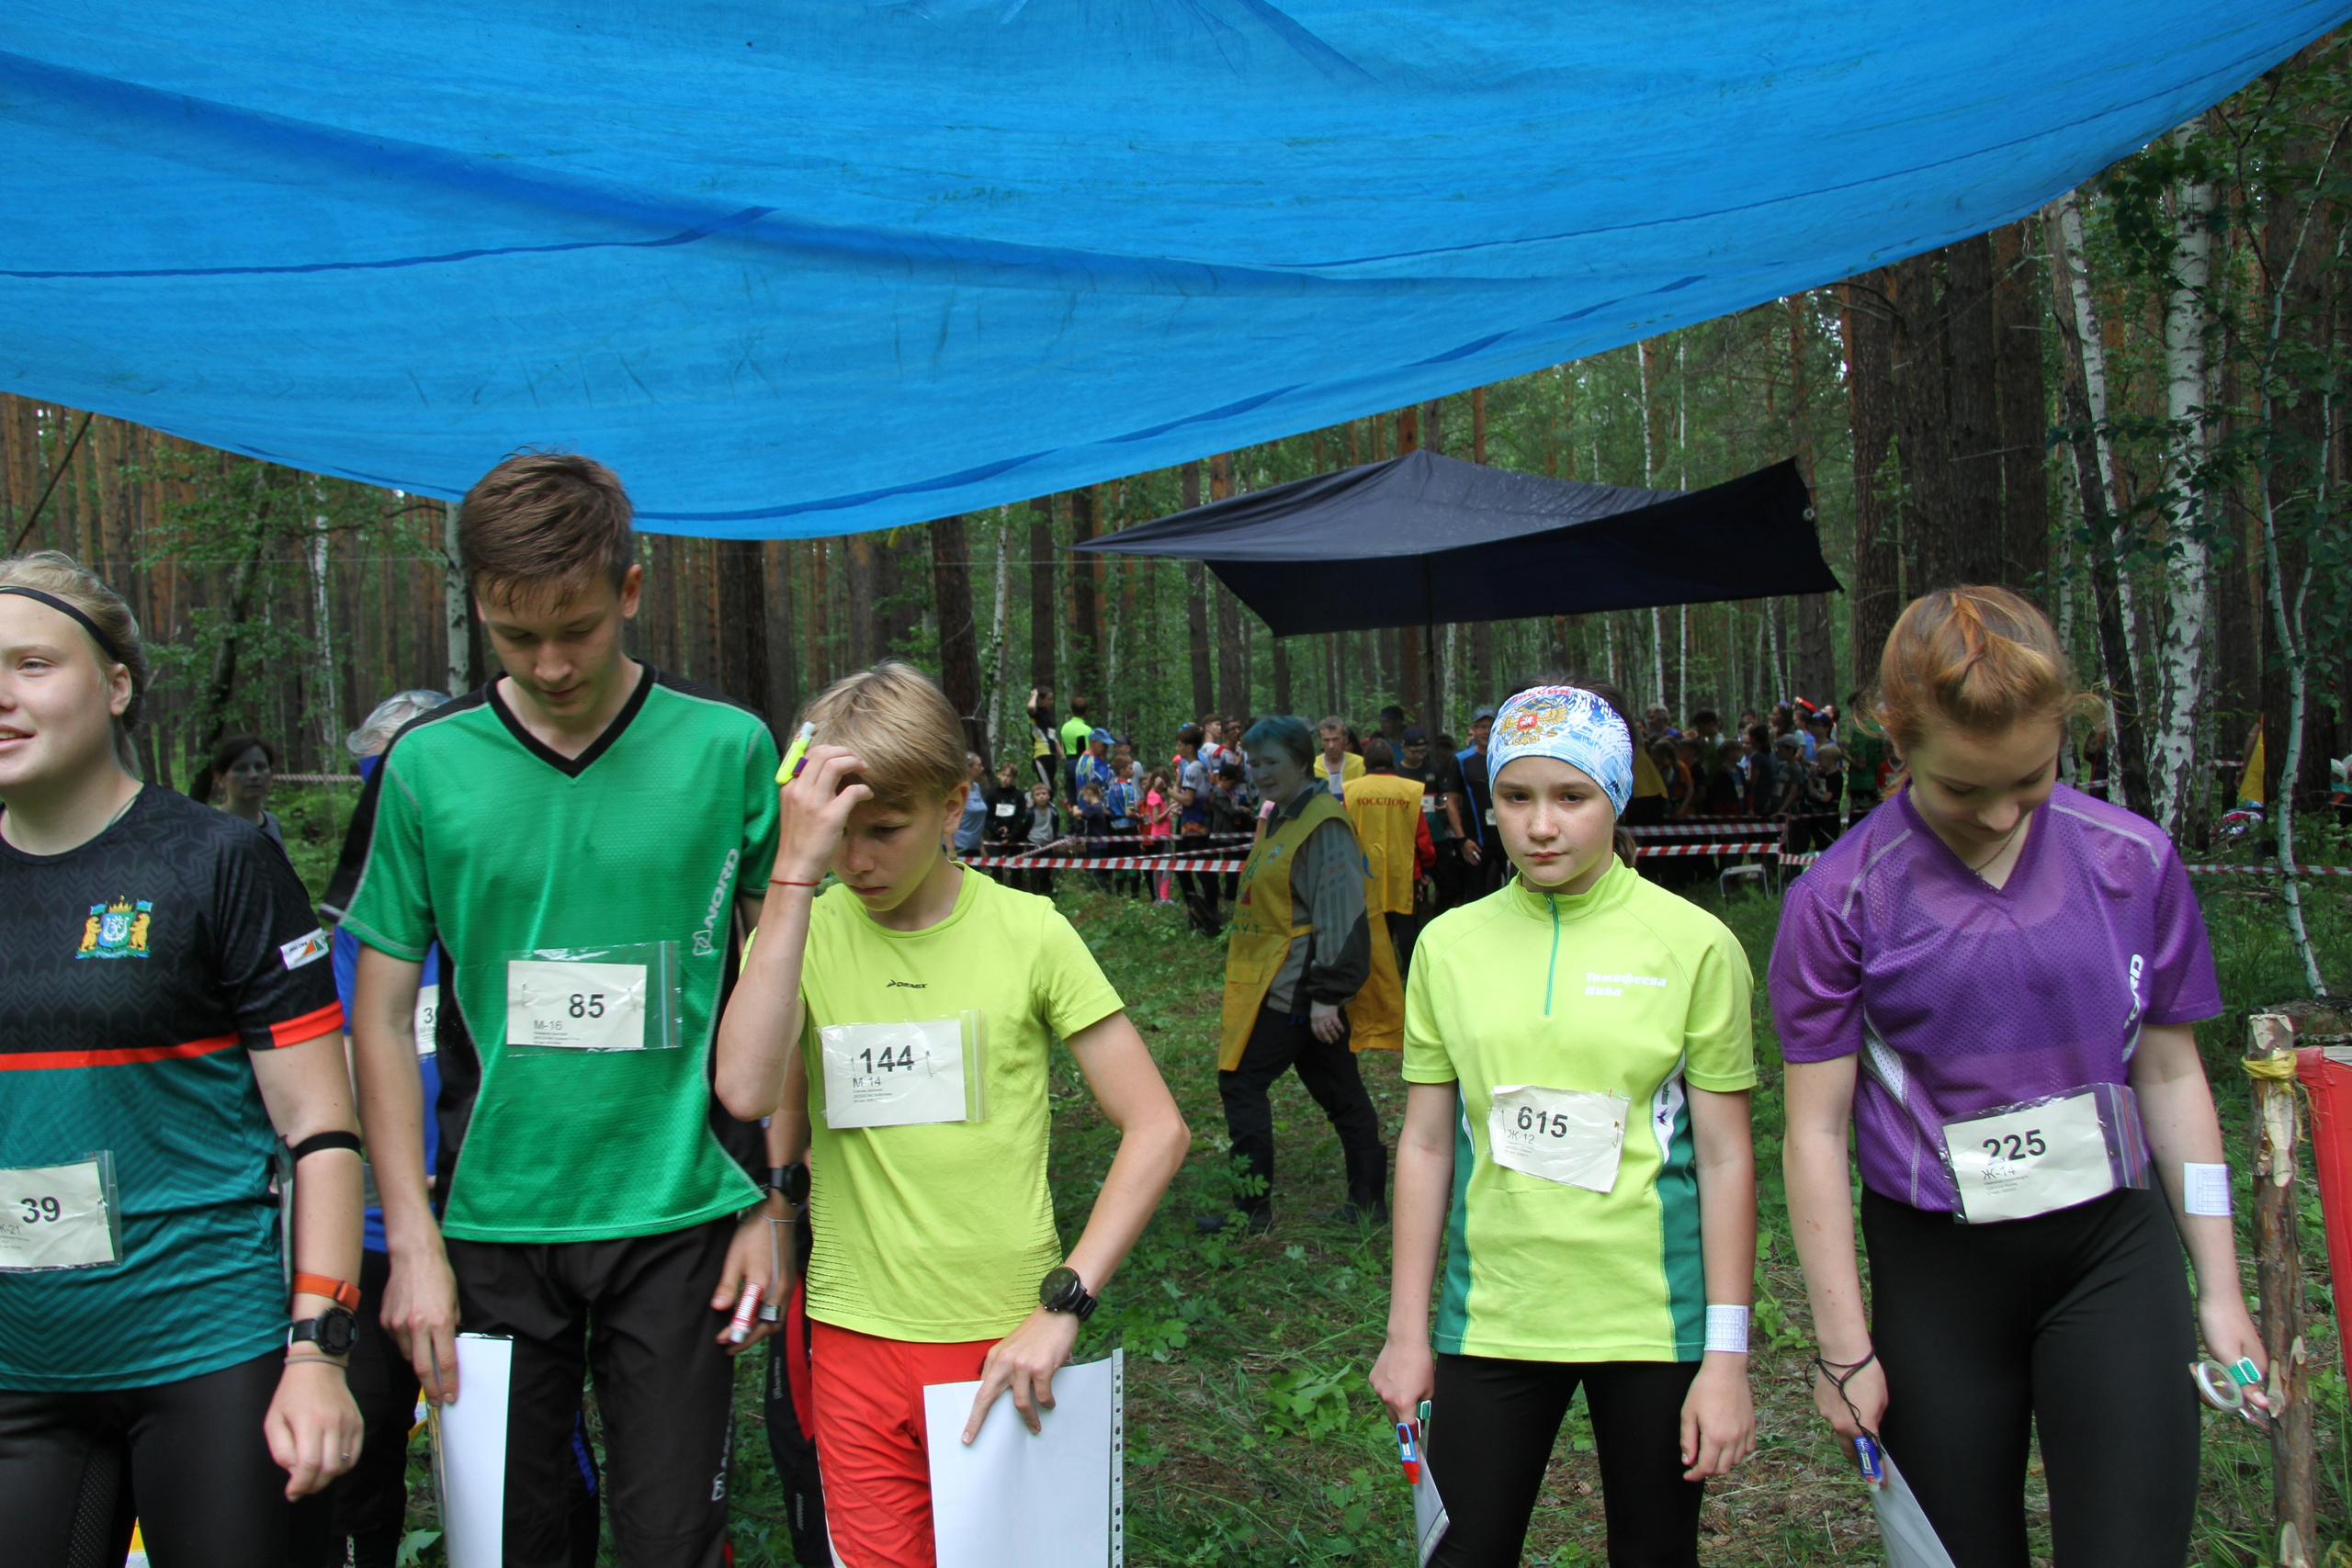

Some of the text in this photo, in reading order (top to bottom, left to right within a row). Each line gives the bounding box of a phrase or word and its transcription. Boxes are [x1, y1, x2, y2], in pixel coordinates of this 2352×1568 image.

[704, 848, 739, 930] NORD
[897, 981, 928, 989] DEMIX
[1585, 972, 1668, 987] Тимофеева
[2123, 953, 2143, 1029] ORD
[569, 993, 605, 1019] 85
[860, 1044, 915, 1074] 144
[1517, 1106, 1569, 1138] 615
[1508, 1129, 1535, 1145] Ж-12
[1983, 1129, 2046, 1166] 225
[21, 1196, 62, 1224] 39
